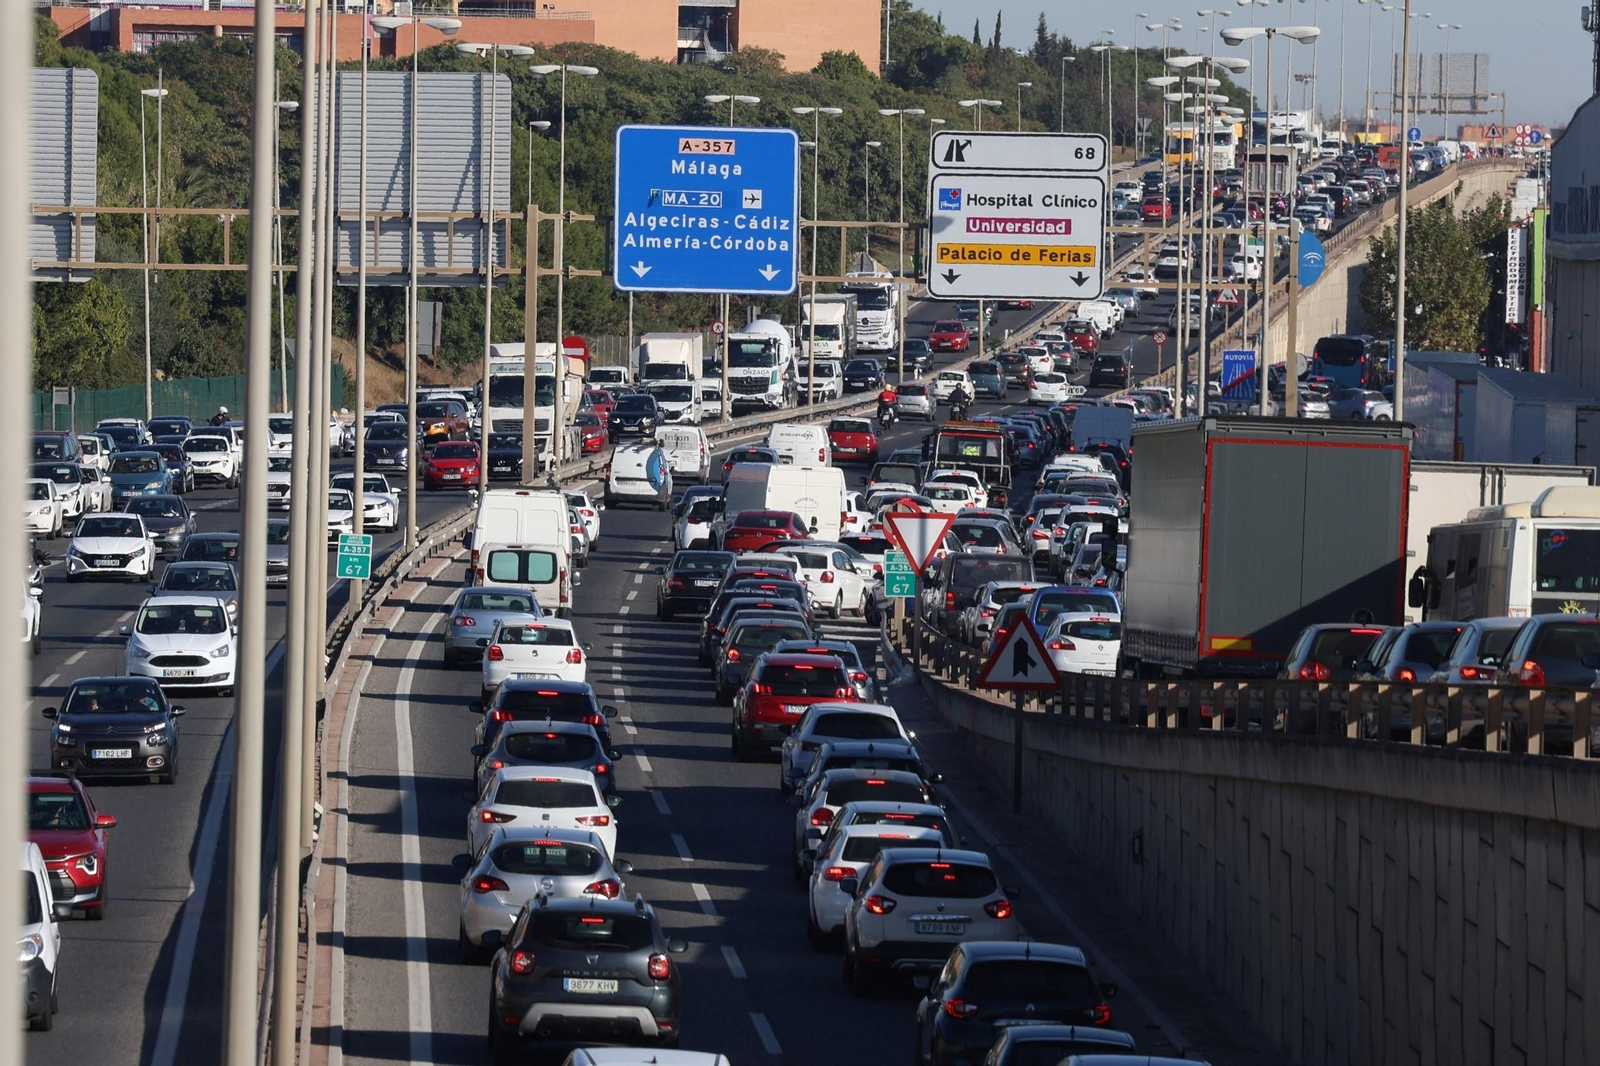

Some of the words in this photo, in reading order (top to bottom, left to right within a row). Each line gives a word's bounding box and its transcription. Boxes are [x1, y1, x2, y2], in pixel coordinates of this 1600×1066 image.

[681, 140, 734, 153] A-357
[1074, 147, 1096, 160] 68
[671, 159, 742, 179] Málaga
[663, 192, 721, 206] MA-20
[966, 193, 1033, 209] Hospital
[1041, 194, 1098, 209] Clínico
[969, 219, 1066, 234] Universidad
[940, 247, 1003, 261] Palacio
[1010, 249, 1031, 261] de
[1039, 249, 1092, 263] Ferias
[343, 545, 367, 554] A-357
[345, 565, 362, 575] 67
[892, 583, 910, 594] 67
[597, 981, 616, 991] KHV
